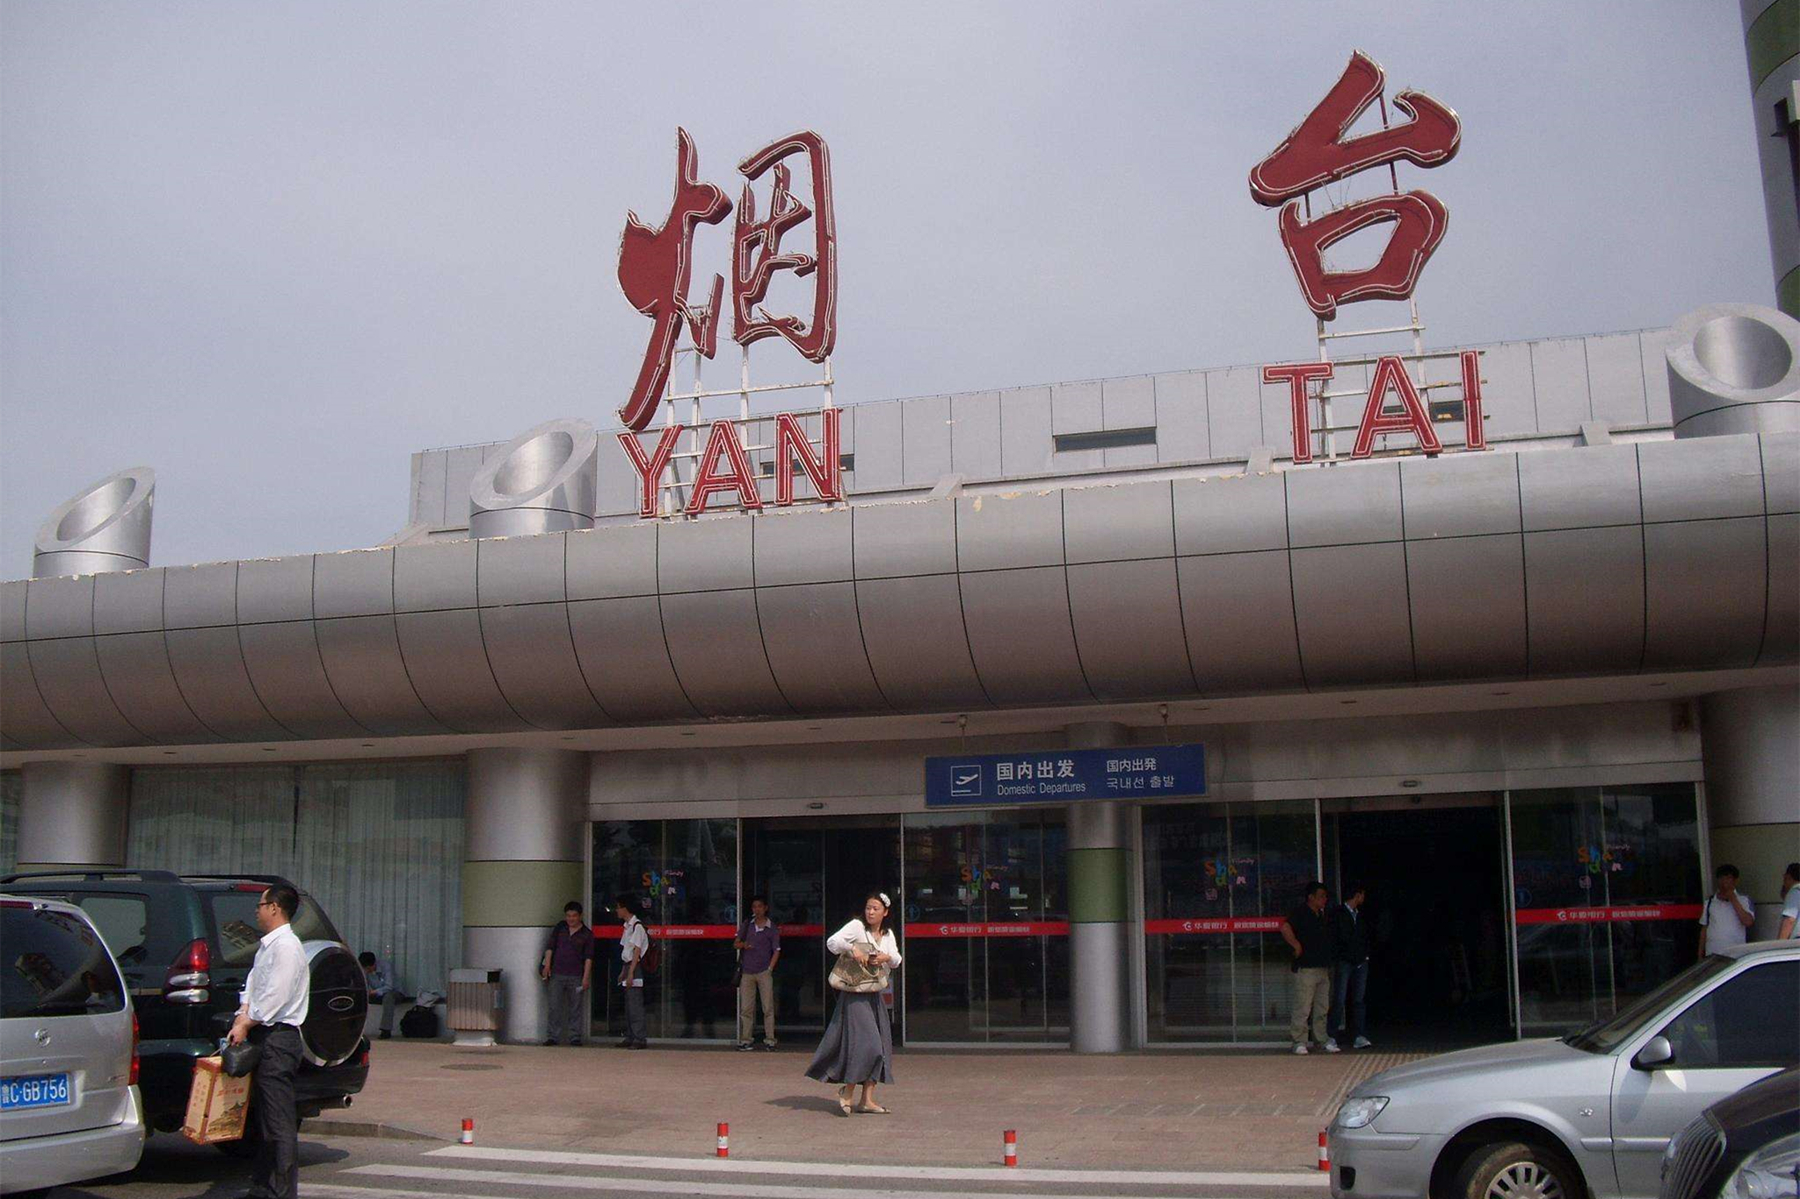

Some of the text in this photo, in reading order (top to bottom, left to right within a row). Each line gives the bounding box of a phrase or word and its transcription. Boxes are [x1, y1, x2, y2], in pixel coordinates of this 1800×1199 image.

[617, 48, 1463, 431] 烟 台
[616, 349, 1486, 519] YAN TAI
[996, 759, 1075, 781] 国内出发
[1106, 757, 1157, 773] 国内出発
[997, 781, 1086, 796] Domestic Departures
[1106, 775, 1175, 790] 국내선 출발
